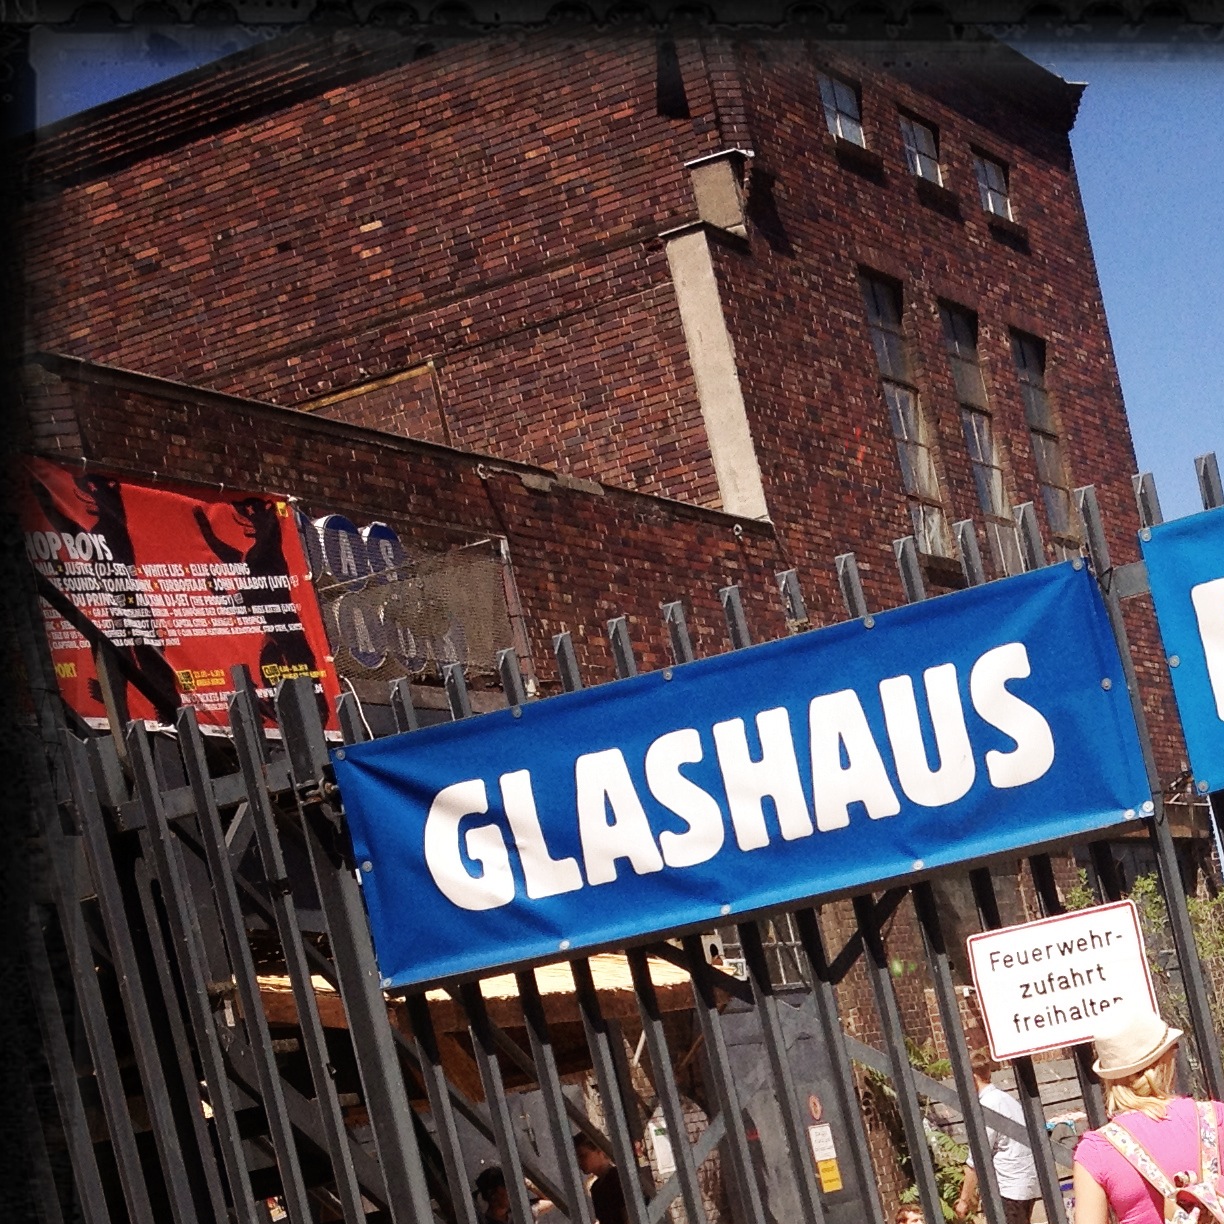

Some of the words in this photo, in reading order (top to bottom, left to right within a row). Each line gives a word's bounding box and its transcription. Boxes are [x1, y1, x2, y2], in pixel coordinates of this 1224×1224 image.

[61, 532, 114, 561] BOYS
[62, 578, 100, 591] SOUNDS
[64, 562, 95, 576] JUSTICE
[425, 642, 1055, 912] GLASHAUS
[989, 929, 1123, 971] Feuerwehr-
[1019, 963, 1106, 999] zufahrt
